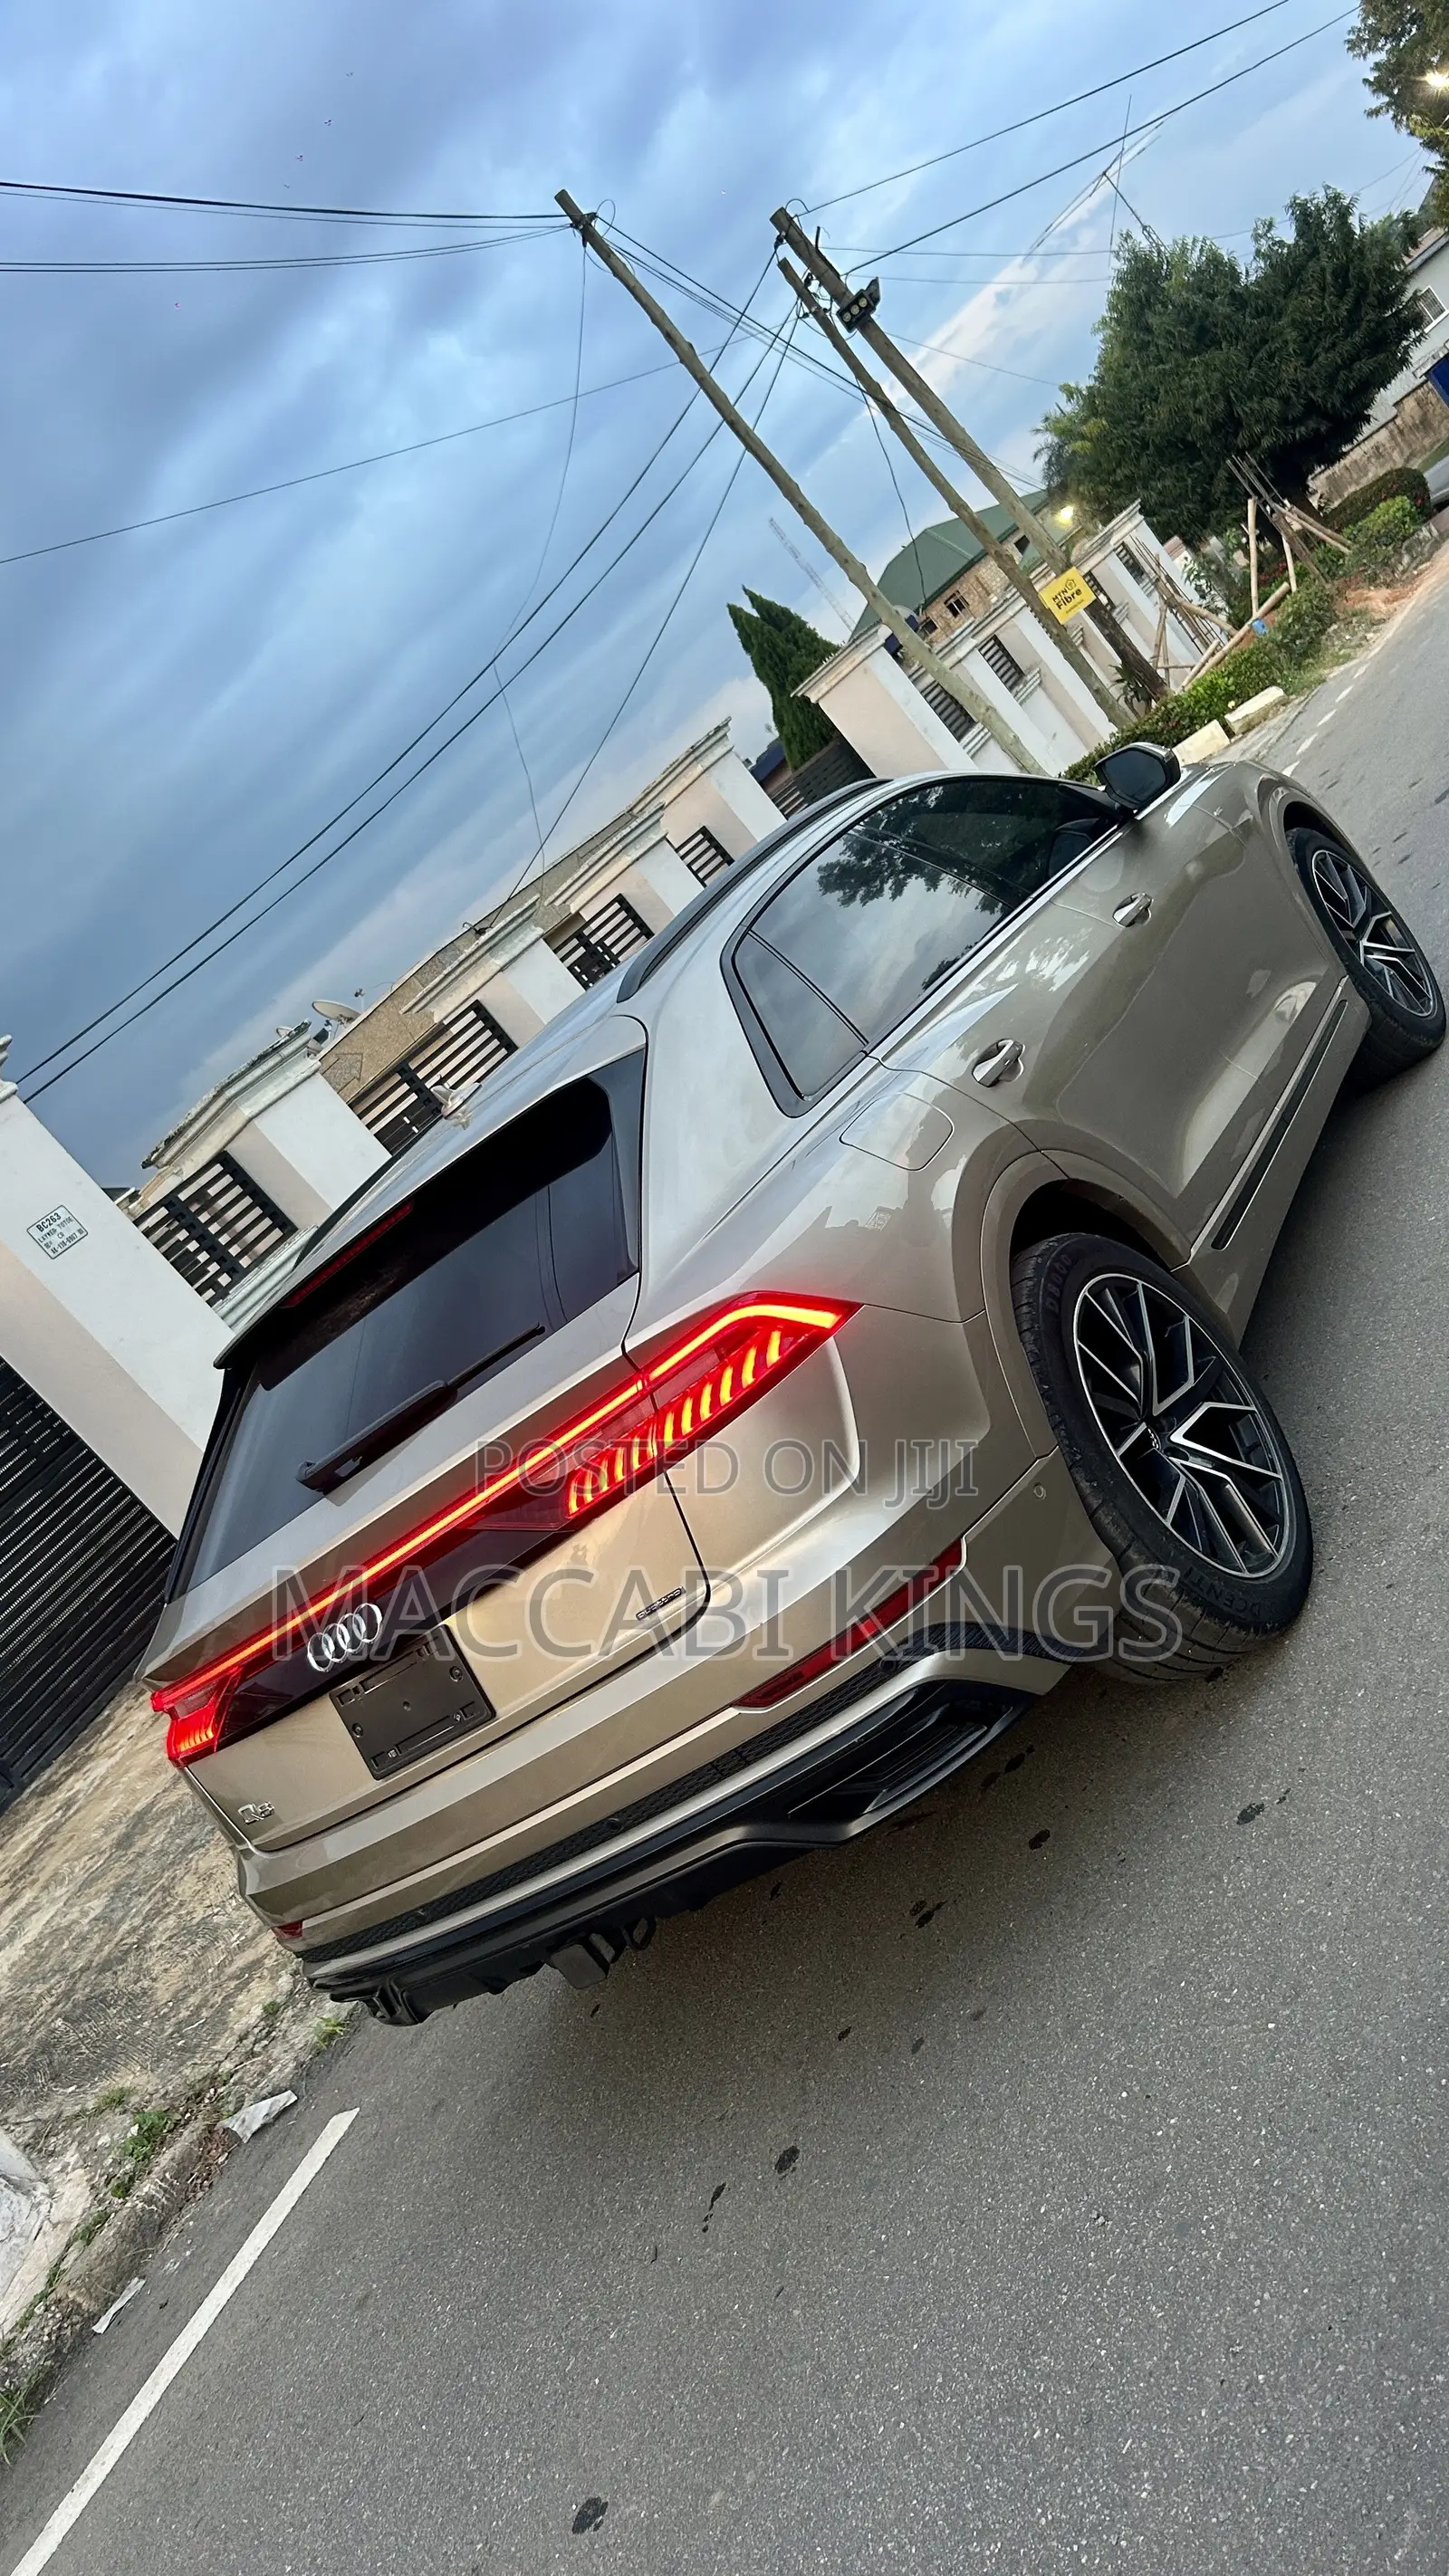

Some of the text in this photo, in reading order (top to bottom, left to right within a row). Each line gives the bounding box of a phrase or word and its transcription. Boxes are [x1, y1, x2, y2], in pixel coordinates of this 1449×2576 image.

[1051, 588, 1069, 603] MTN
[1055, 589, 1083, 610] Fibre
[35, 1212, 62, 1232] BC263
[637, 1588, 683, 1619] quattro
[237, 1800, 275, 1824] Q8
